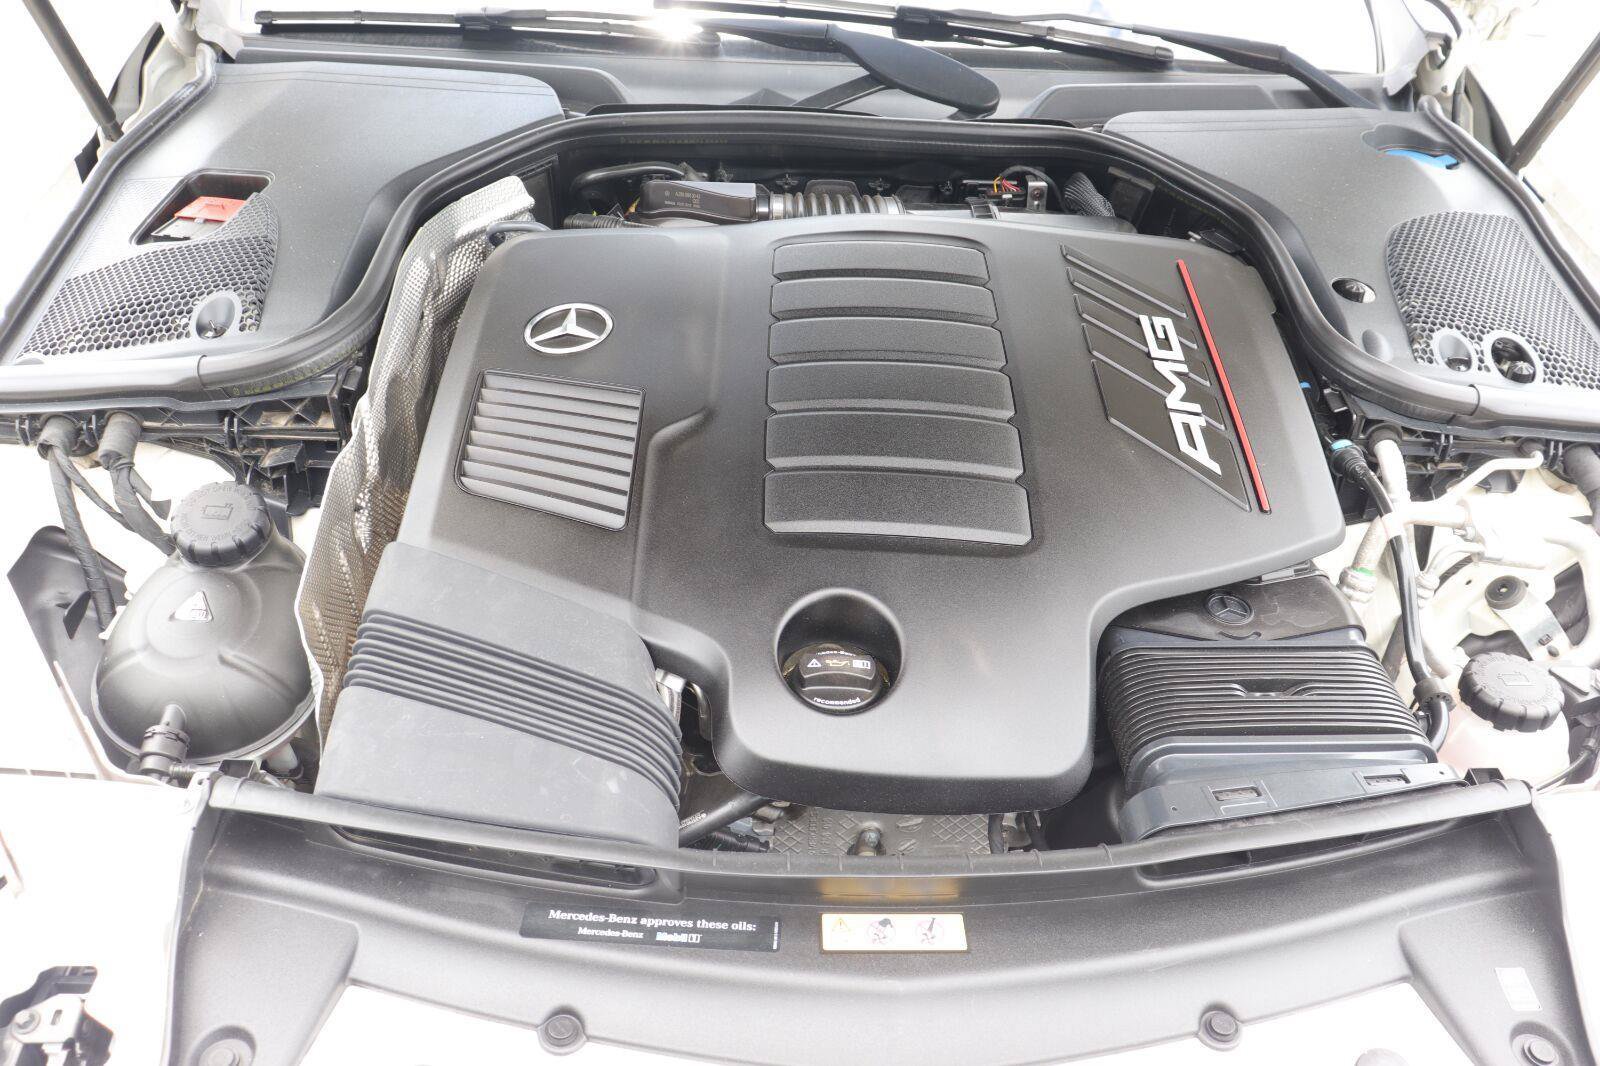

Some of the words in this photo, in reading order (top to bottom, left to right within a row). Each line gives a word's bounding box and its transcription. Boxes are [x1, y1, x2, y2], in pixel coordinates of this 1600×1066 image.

[1138, 314, 1222, 476] AMG
[813, 696, 861, 706] recommended
[548, 909, 638, 924] Mercedes-Benz
[640, 917, 694, 928] approves
[696, 919, 729, 930] these
[731, 921, 757, 932] oils:
[577, 926, 645, 938] Mercedes-Benz
